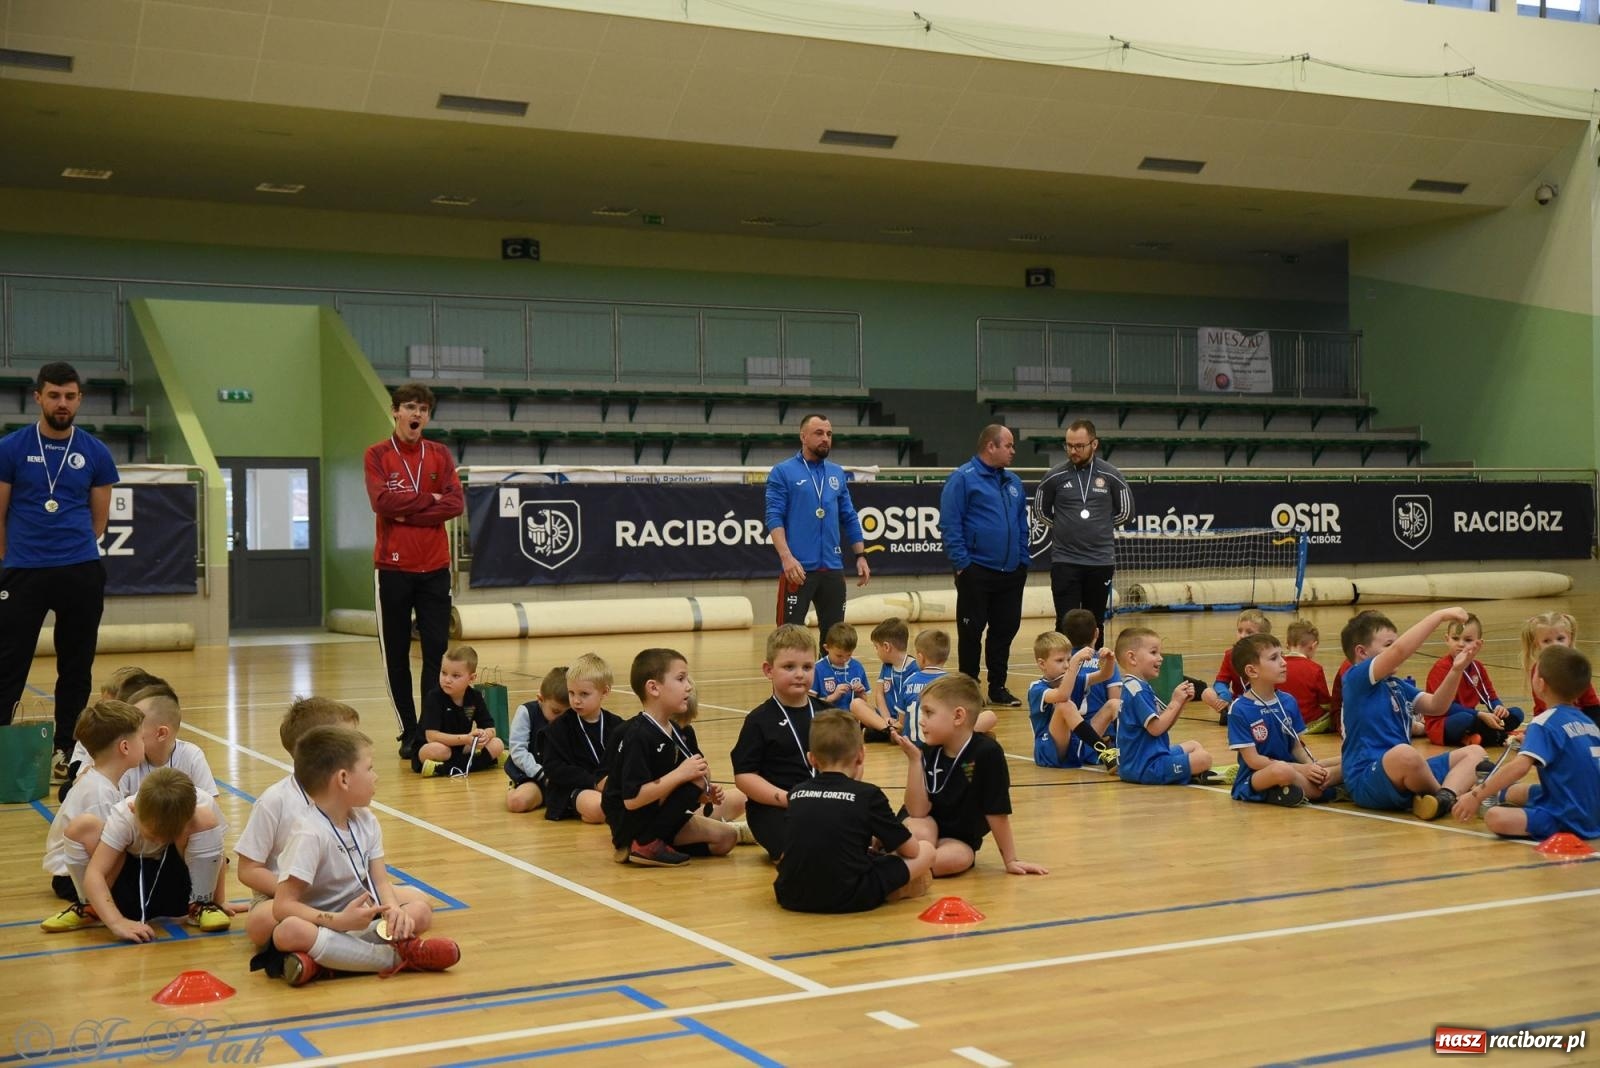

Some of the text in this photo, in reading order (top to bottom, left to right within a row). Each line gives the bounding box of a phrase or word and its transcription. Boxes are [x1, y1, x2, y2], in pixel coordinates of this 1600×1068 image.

[116, 497, 126, 511] B
[505, 495, 514, 509] A
[1453, 504, 1563, 534] RACIBÓRZ
[890, 541, 943, 553] RACIBÓRZ
[797, 789, 822, 799] CZARNI
[822, 790, 857, 802] GORZYCE
